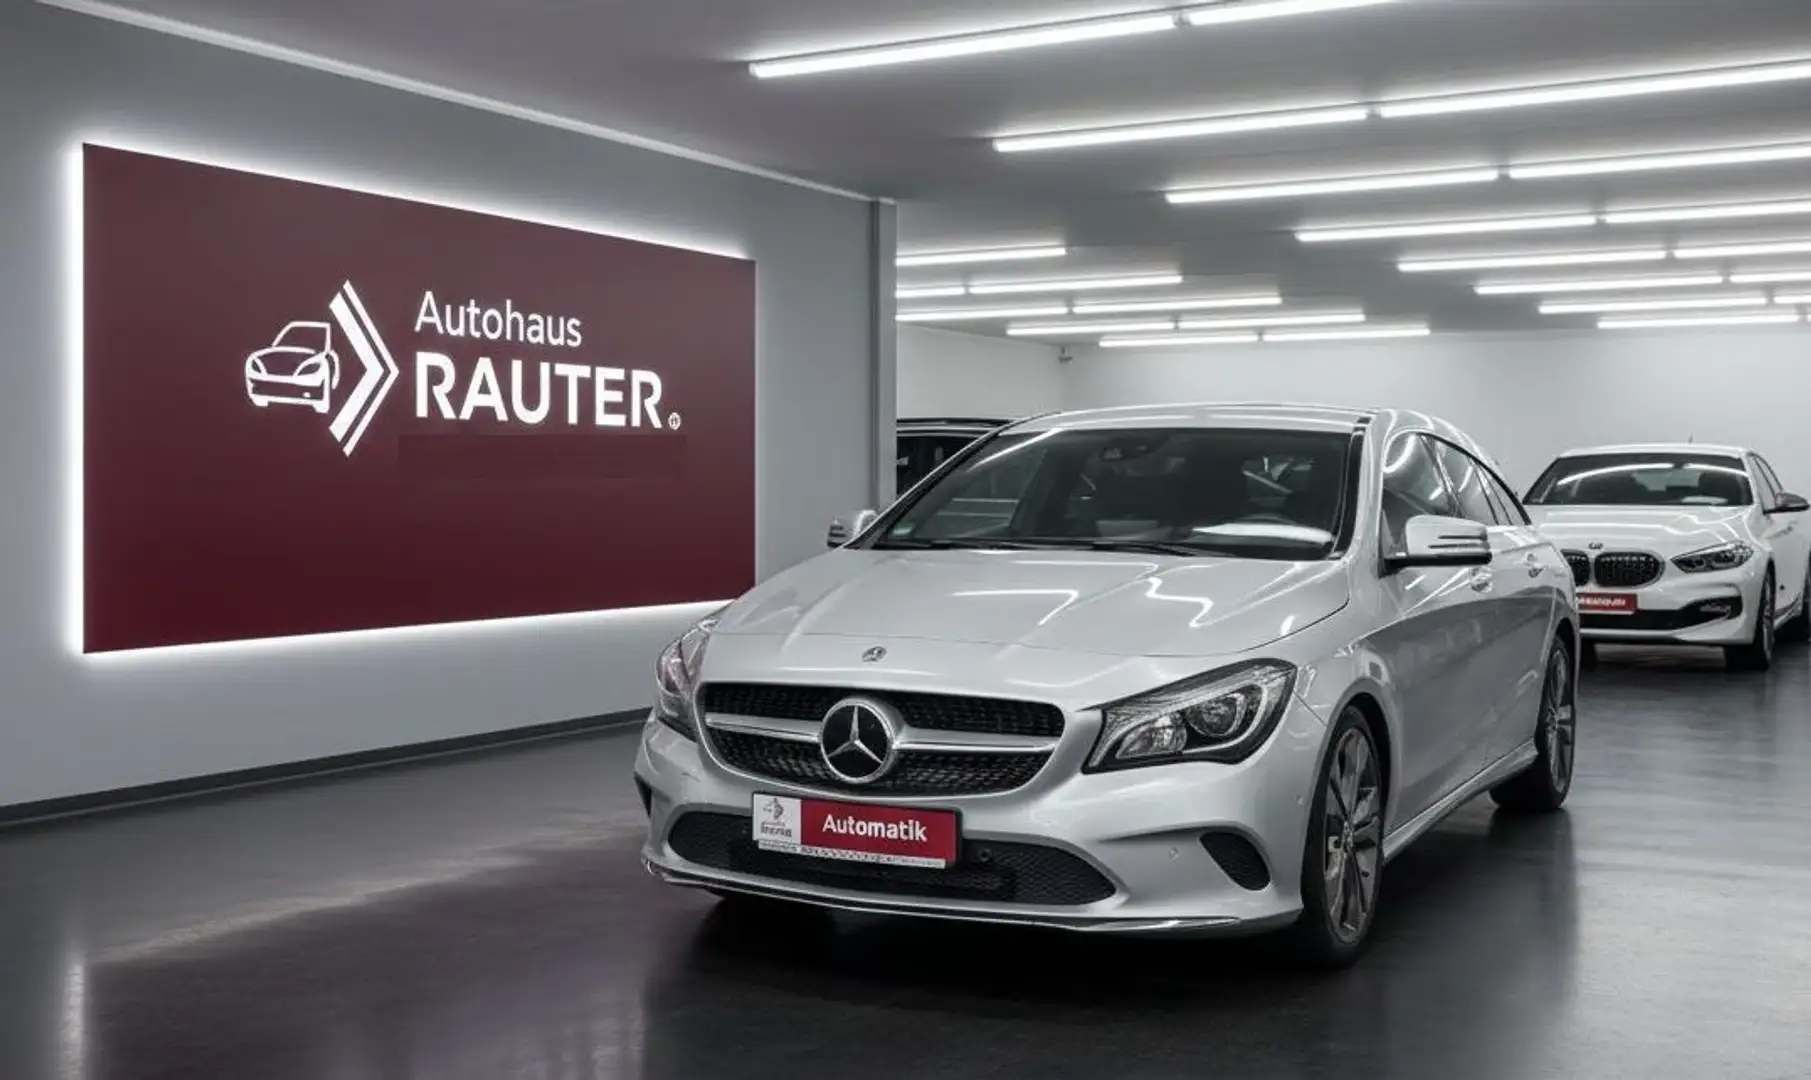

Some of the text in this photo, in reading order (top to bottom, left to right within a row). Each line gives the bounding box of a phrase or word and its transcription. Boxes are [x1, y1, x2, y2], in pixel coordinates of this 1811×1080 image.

[414, 290, 583, 348] Autohaus
[415, 351, 663, 429] RAUTER
[822, 814, 927, 842] Automatik
